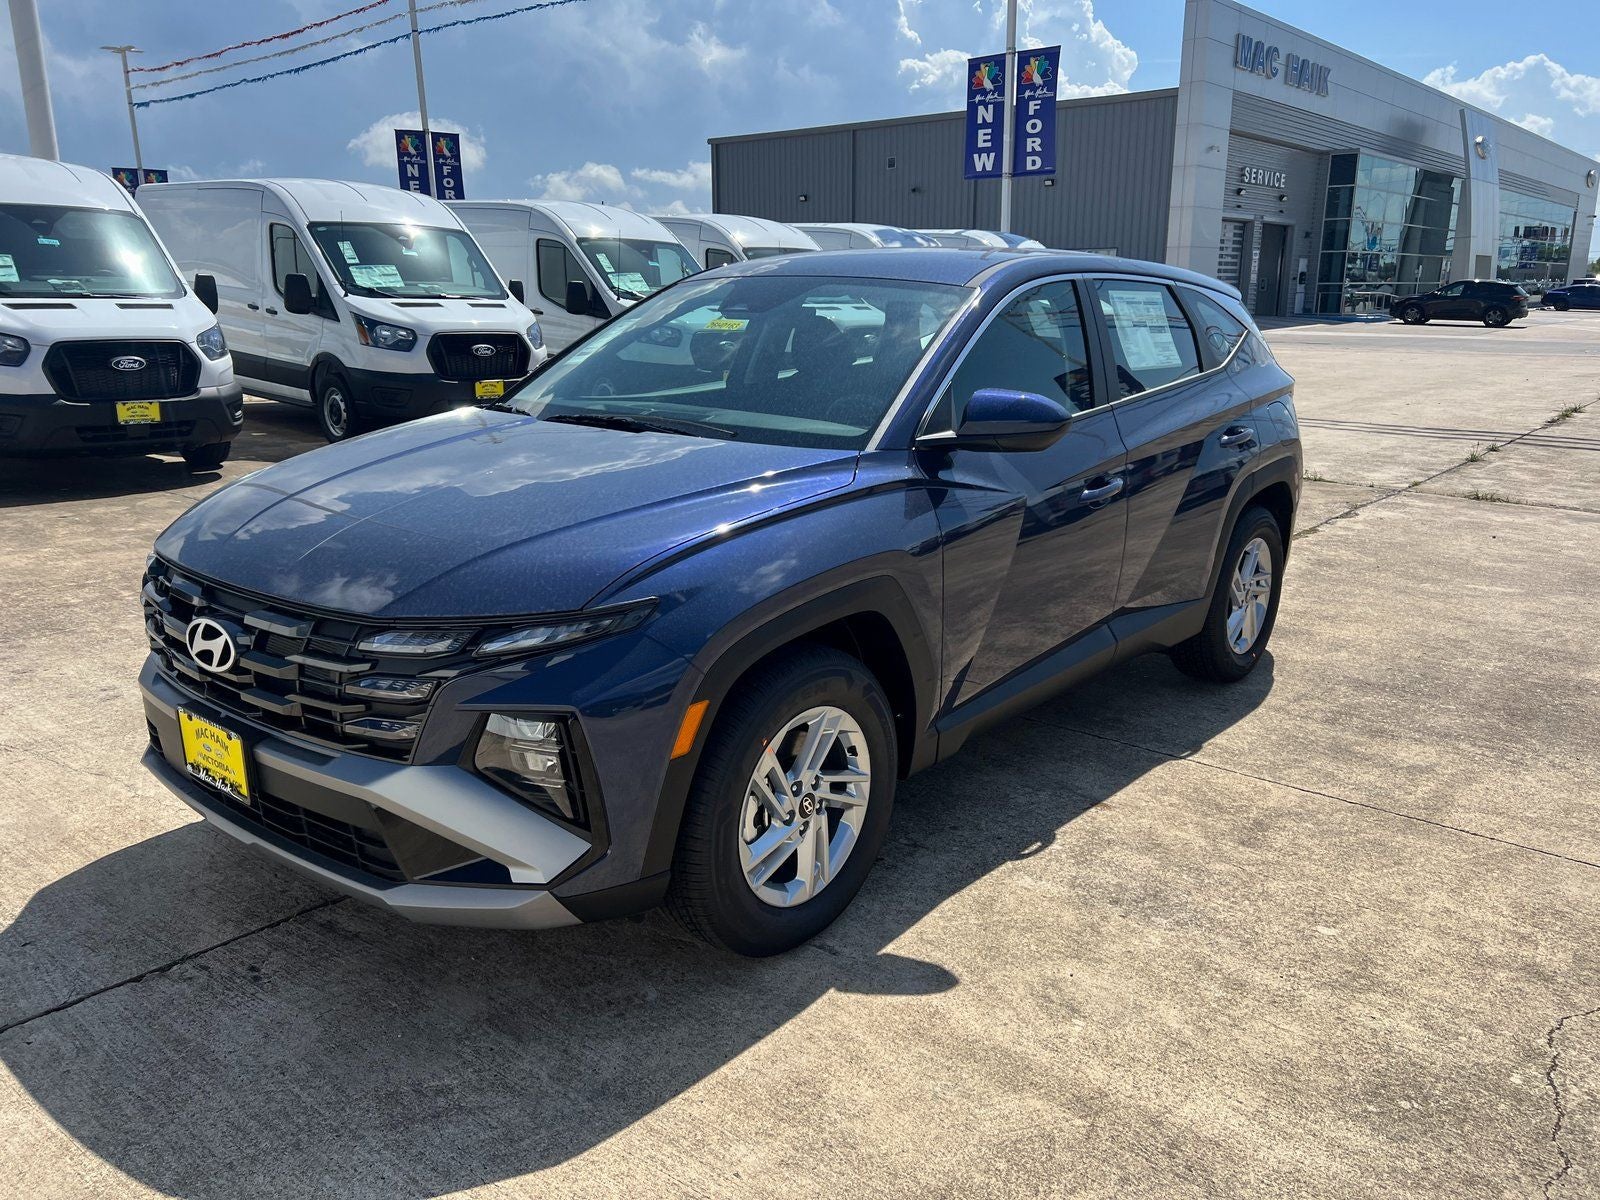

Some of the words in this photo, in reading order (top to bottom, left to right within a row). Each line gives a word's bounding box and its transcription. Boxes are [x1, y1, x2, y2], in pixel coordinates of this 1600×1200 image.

[1234, 33, 1280, 79] MAC
[1284, 53, 1331, 97] HAIK
[973, 104, 996, 172] NEW
[1025, 100, 1043, 171] FORD
[406, 164, 420, 193] NE
[442, 165, 456, 200] FOR
[1243, 166, 1287, 188] SERVICE
[118, 359, 140, 369] Ford
[195, 727, 209, 741] MAC
